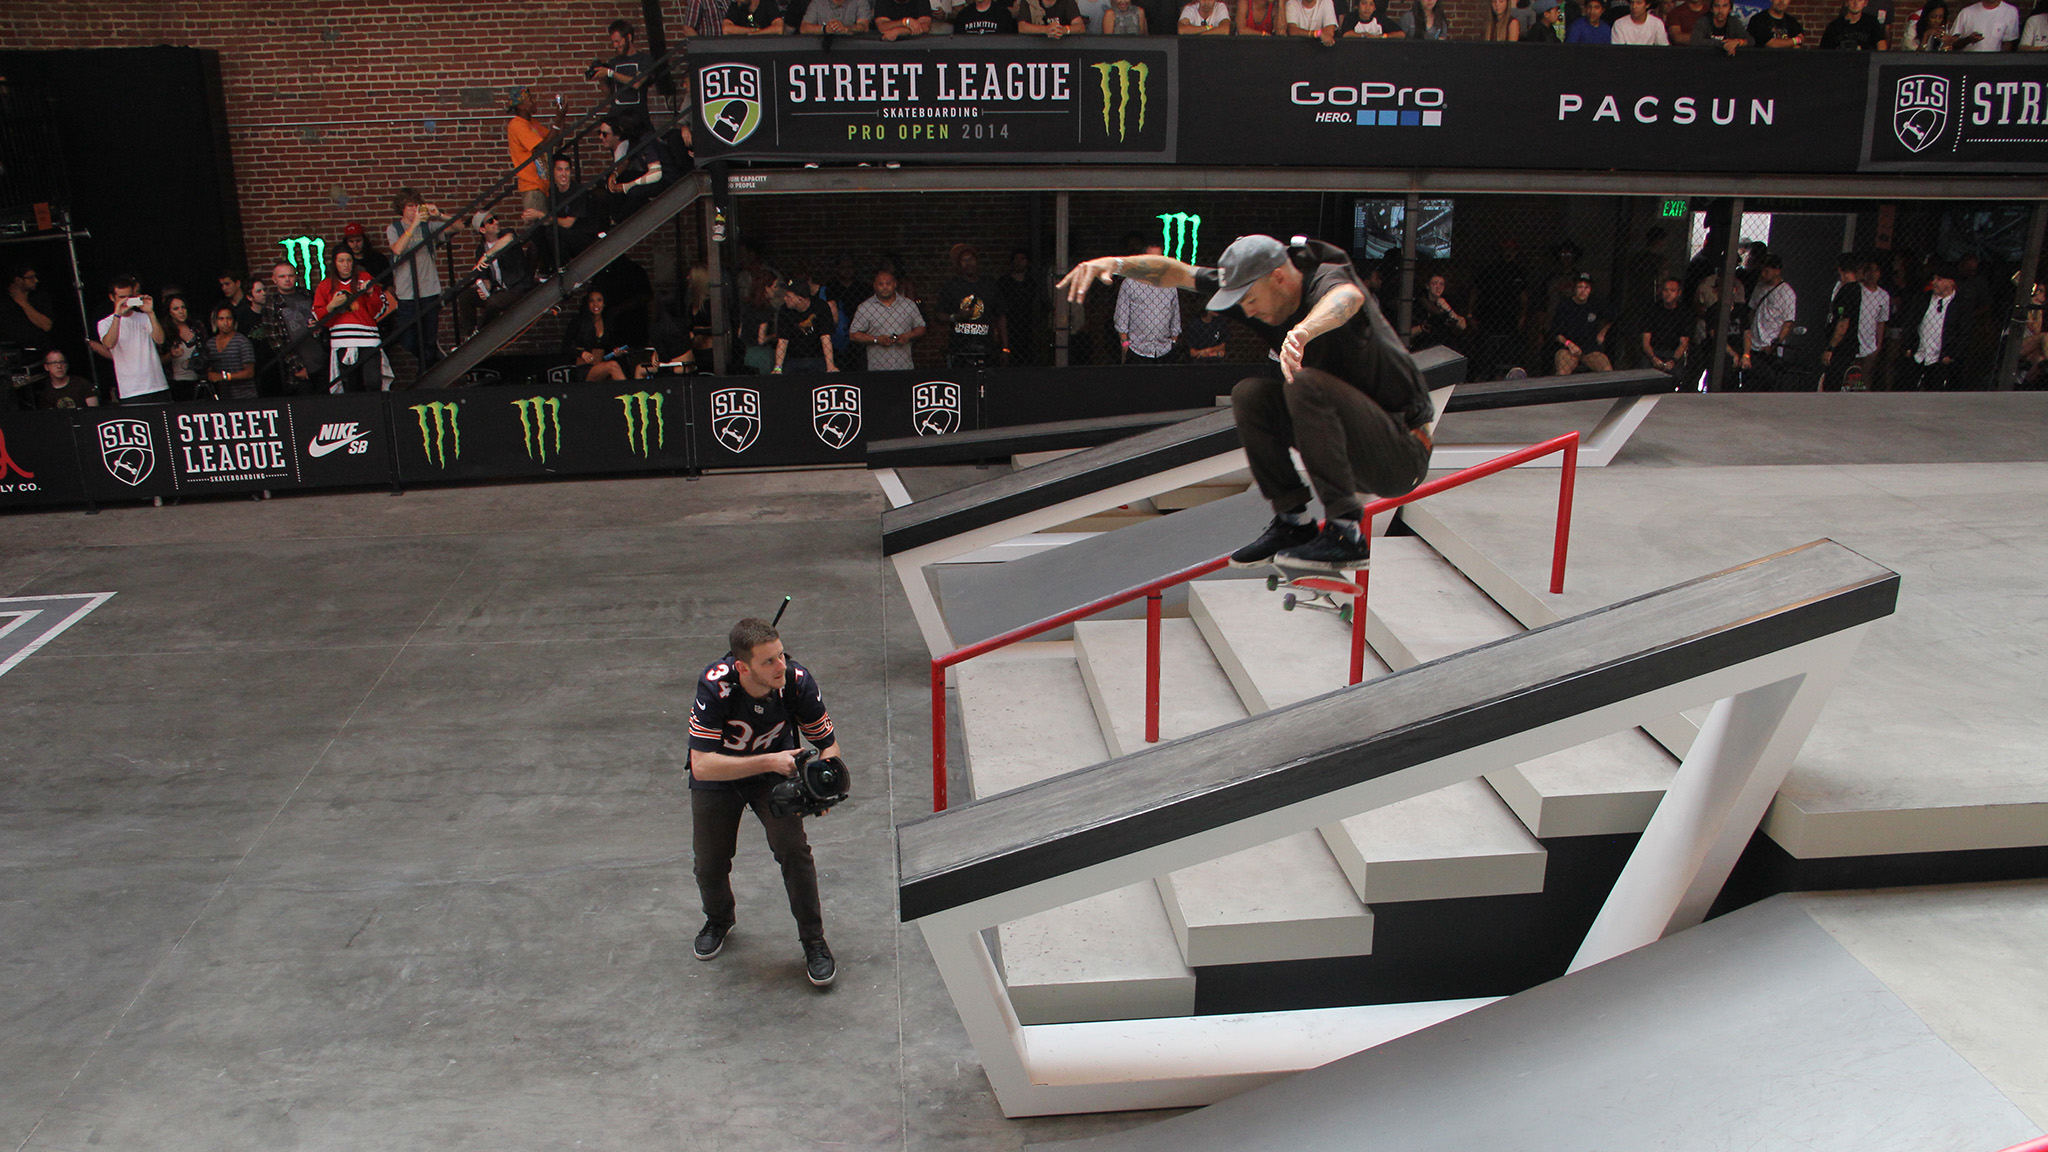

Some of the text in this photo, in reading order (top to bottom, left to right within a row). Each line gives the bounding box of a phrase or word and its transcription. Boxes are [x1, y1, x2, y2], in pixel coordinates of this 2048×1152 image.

[705, 69, 756, 98] SLS
[789, 62, 1070, 103] STREET LEAGUE
[1290, 81, 1444, 107] GoPro
[1899, 80, 1945, 107] SLS
[883, 106, 979, 119] SKATEBOARDING
[1558, 93, 1774, 126] PACSUN
[1972, 81, 2048, 126] STR
[1315, 111, 1353, 123] HERO.
[848, 123, 1009, 141] PRO OPEN 2014
[1662, 200, 1684, 216] EXIT
[714, 390, 758, 416] SLS
[816, 388, 858, 412] SLS
[916, 384, 957, 409] SLS
[102, 422, 149, 449] SLS
[177, 409, 280, 443] STREET
[318, 422, 360, 441] NIKE
[183, 439, 287, 474] LEAGUE
[347, 440, 369, 454] SB
[18, 482, 42, 492] CO.
[209, 472, 266, 483] SKATEBOARDING
[723, 719, 786, 751] 34
